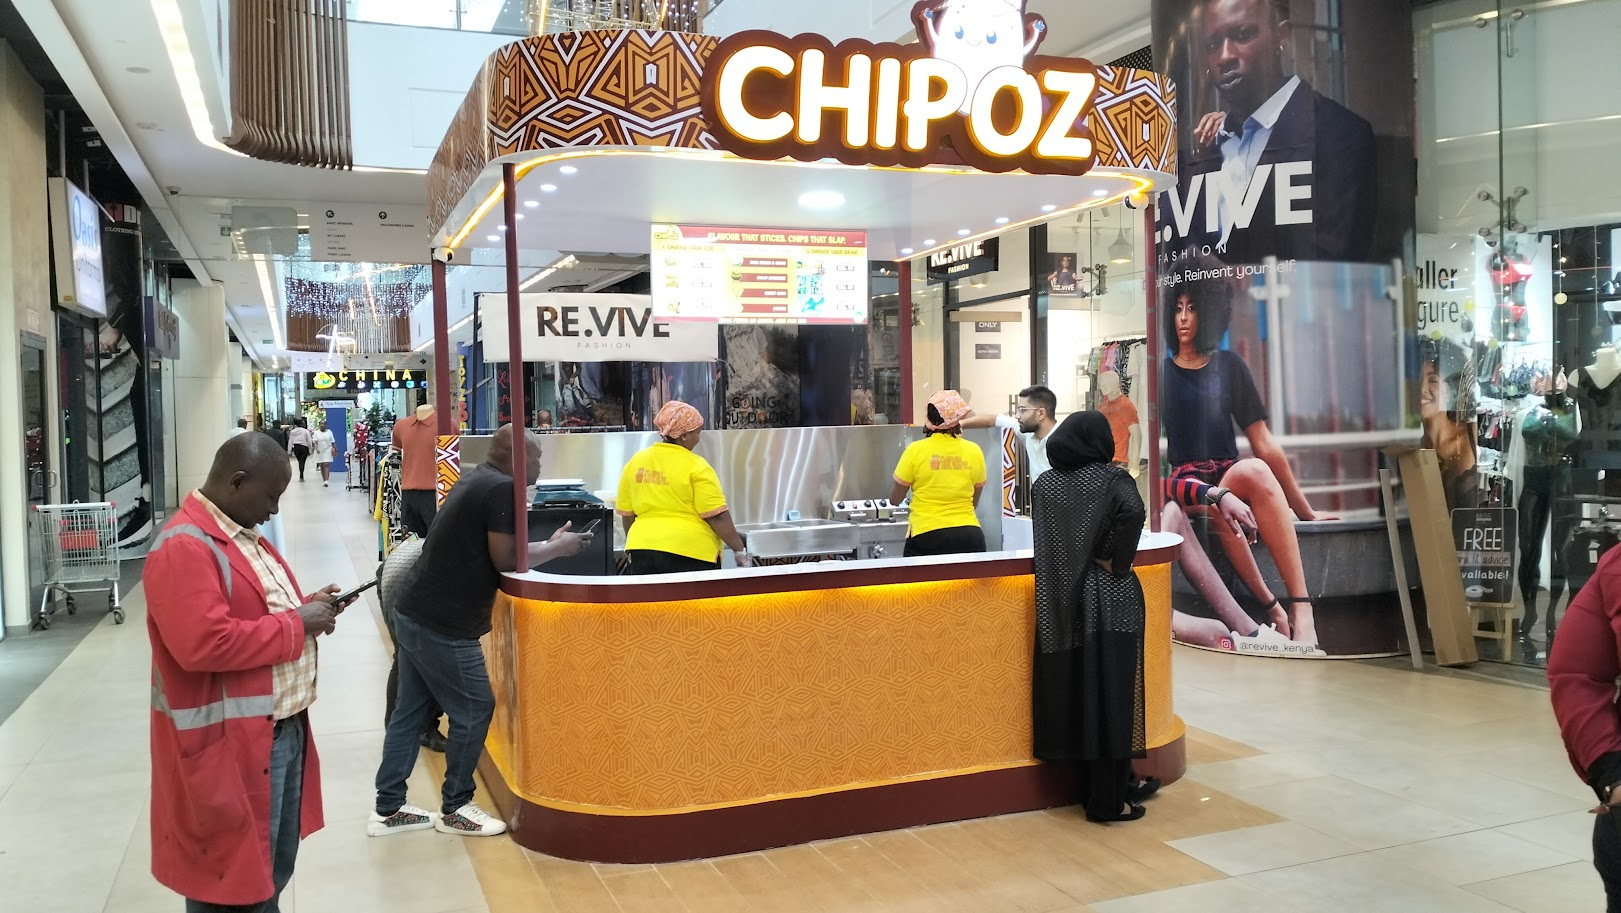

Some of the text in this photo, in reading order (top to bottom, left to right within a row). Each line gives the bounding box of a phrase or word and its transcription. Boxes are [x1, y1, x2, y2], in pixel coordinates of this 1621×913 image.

[716, 45, 1096, 160] CHIPOZ
[1155, 161, 1313, 244] .VIVE
[741, 233, 759, 241] THAT
[788, 234, 809, 243] CHIPS
[810, 235, 828, 243] THAT
[1158, 243, 1227, 265] FASHION
[948, 263, 970, 274] FASHION
[1163, 270, 1182, 288] style.
[1184, 265, 1234, 282] Reinvent
[1236, 259, 1296, 278] yourself.
[1417, 300, 1459, 331] gure
[338, 369, 412, 382] CHINA
[732, 396, 776, 410] GOING
[1463, 527, 1502, 551] FREE
[1483, 552, 1508, 565] advice
[1461, 569, 1509, 580] vailable!
[1240, 641, 1315, 655] @revive_kenya
